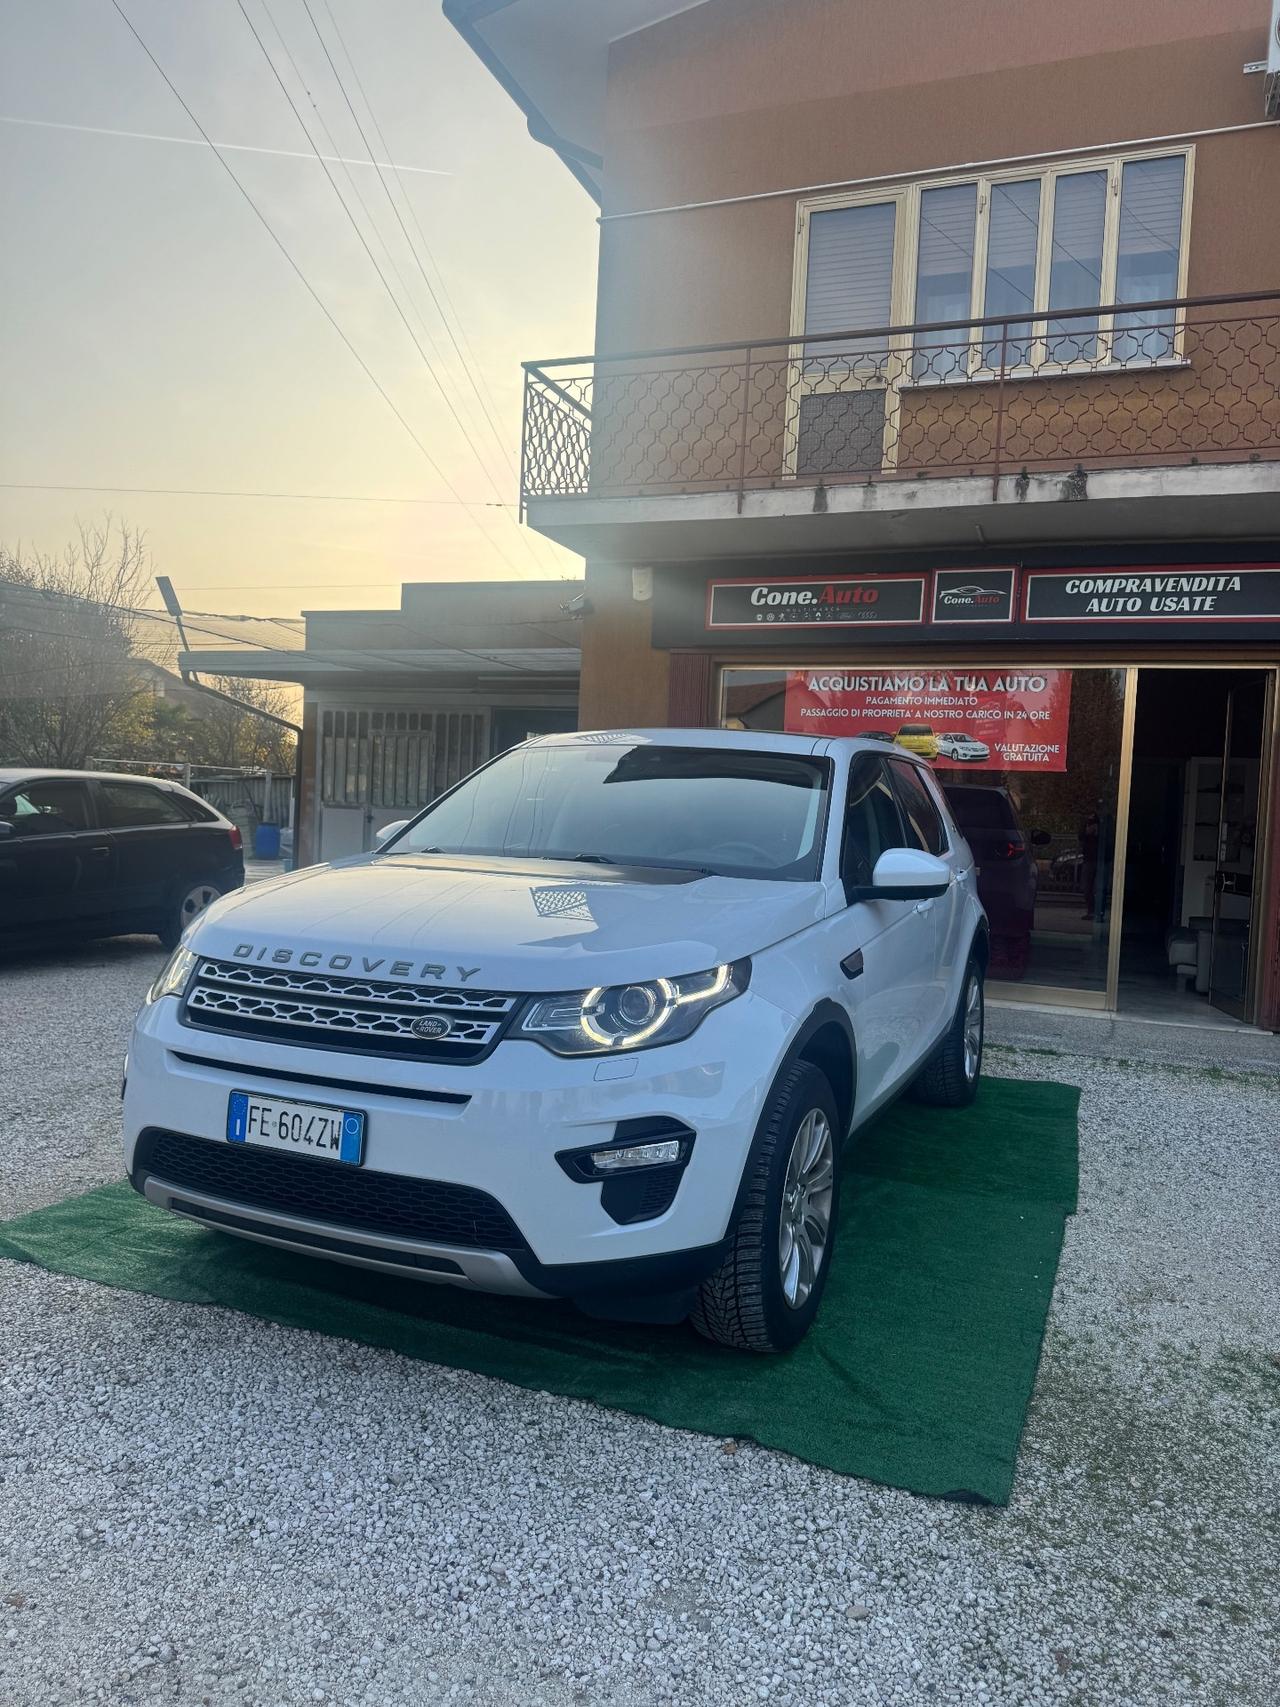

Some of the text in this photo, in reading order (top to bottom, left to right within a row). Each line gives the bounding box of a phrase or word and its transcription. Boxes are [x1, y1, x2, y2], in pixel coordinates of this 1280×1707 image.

[1065, 576, 1242, 594] COMPRAVENDITA
[1086, 596, 1217, 613] AUTO USATE
[808, 676, 1046, 692] ACQUISTIAMO LA TUA AUTO
[865, 696, 978, 706] PAGAMENTO IMMEDIATO
[800, 708, 849, 717] PASSAGGIO
[850, 708, 860, 717] DI
[914, 710, 922, 718] A
[923, 709, 964, 718] NOSTRO
[965, 709, 1002, 719] CARICO
[1004, 710, 1014, 719] IN
[1016, 711, 1028, 719] 24
[1029, 711, 1051, 720] ORE
[994, 743, 1060, 753] VALUTAZIONE
[1003, 752, 1050, 762] GRATUITA
[232, 943, 481, 982] DISCOVERY
[421, 1026, 442, 1034] ROVER
